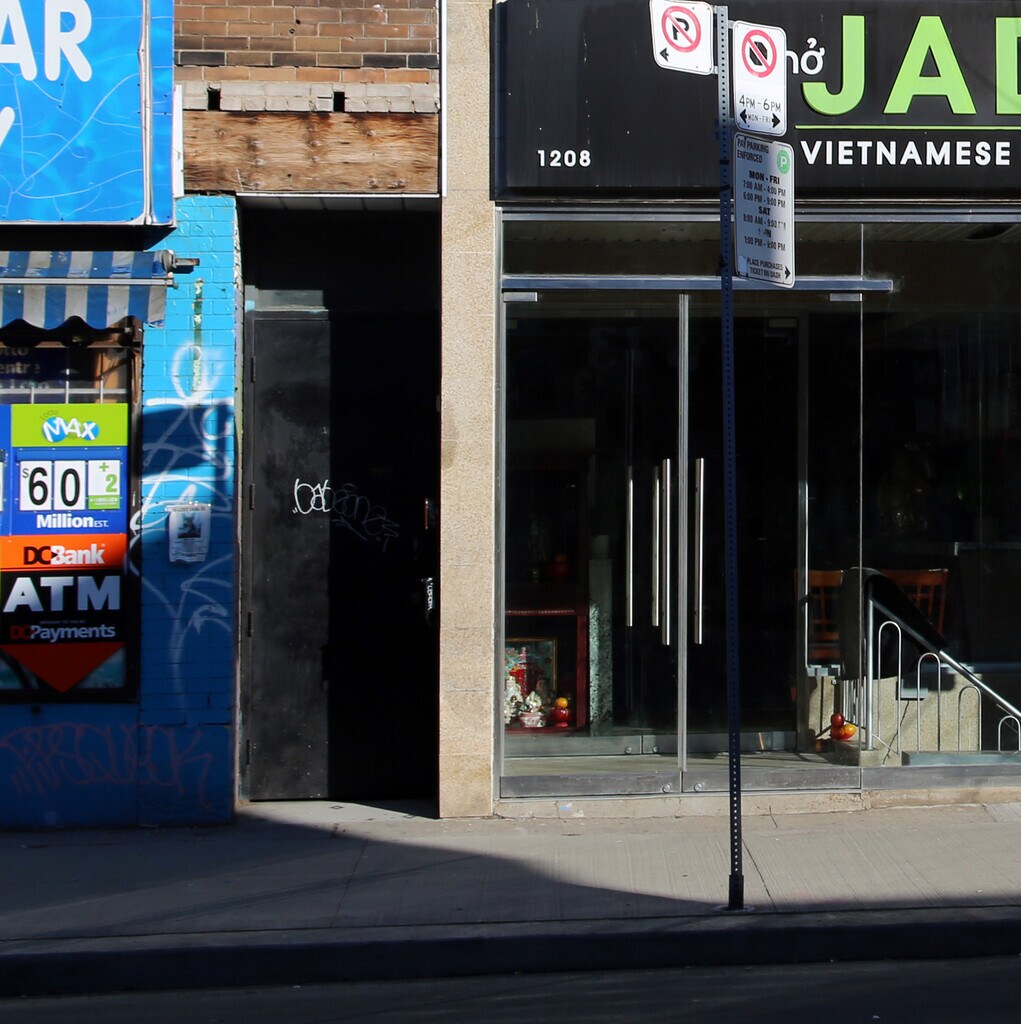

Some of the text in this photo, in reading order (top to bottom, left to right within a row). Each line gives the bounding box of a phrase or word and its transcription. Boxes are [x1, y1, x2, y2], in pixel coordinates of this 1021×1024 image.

[739, 94, 756, 108] 4PM
[763, 98, 781, 112] 6PM
[746, 140, 770, 154] PARKING
[800, 140, 1011, 167] VIETNAMESE
[537, 149, 592, 167] 1208
[736, 150, 763, 164] ENFORCED
[748, 170, 764, 182] MON
[770, 175, 780, 184] FRI
[754, 182, 763, 192] AM
[778, 188, 786, 196] PM
[754, 194, 763, 203] PM
[778, 200, 786, 208] PM
[758, 206, 771, 216] SAT
[754, 238, 763, 248] PM
[778, 242, 786, 252] PM
[42, 416, 97, 443] MAX
[36, 513, 94, 529] Million
[23, 543, 105, 565] DCBank
[2, 575, 121, 613] ATM
[9, 624, 117, 644] DCPayments
